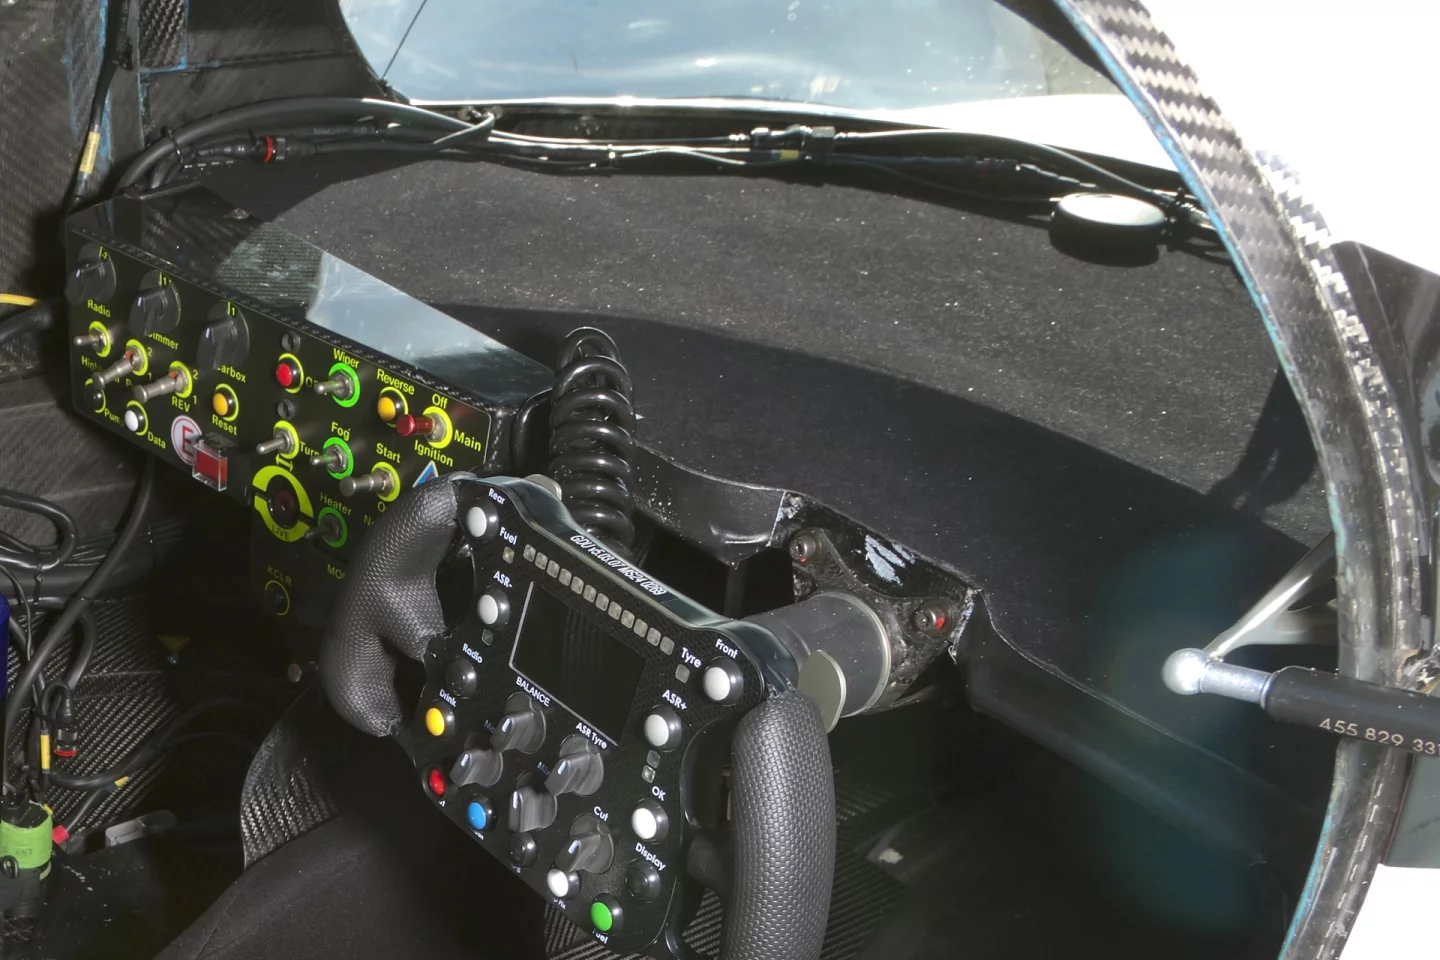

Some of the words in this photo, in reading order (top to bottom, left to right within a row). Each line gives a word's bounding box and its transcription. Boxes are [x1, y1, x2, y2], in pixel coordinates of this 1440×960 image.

[88, 299, 111, 318] Radio
[148, 333, 179, 350] immer
[333, 348, 360, 369] Wiper
[216, 365, 247, 384] arbox
[376, 368, 415, 396] Reverse
[172, 396, 190, 413] REV
[432, 394, 448, 410] Off
[212, 414, 238, 436] Reset
[332, 421, 350, 441] Fog
[148, 431, 166, 449] Data
[454, 429, 482, 452] Main
[376, 443, 402, 463] Start
[414, 440, 454, 467] Ignition
[320, 492, 352, 516] Heater
[488, 488, 505, 504] Rear
[272, 526, 290, 540] LIVE
[500, 526, 518, 545] Fuel
[462, 643, 482, 664] Radio
[681, 648, 702, 668] Tyre
[715, 639, 738, 659] Front
[438, 688, 457, 708] Drink
[516, 676, 550, 708] BALANCE
[662, 690, 687, 711] ASR+
[576, 722, 592, 740] ASR
[592, 732, 608, 750] Tyre
[1319, 718, 1358, 736] 455
[1365, 728, 1404, 746] 829
[652, 786, 666, 802] OK
[594, 806, 609, 822] Cut
[636, 842, 666, 871] Display
